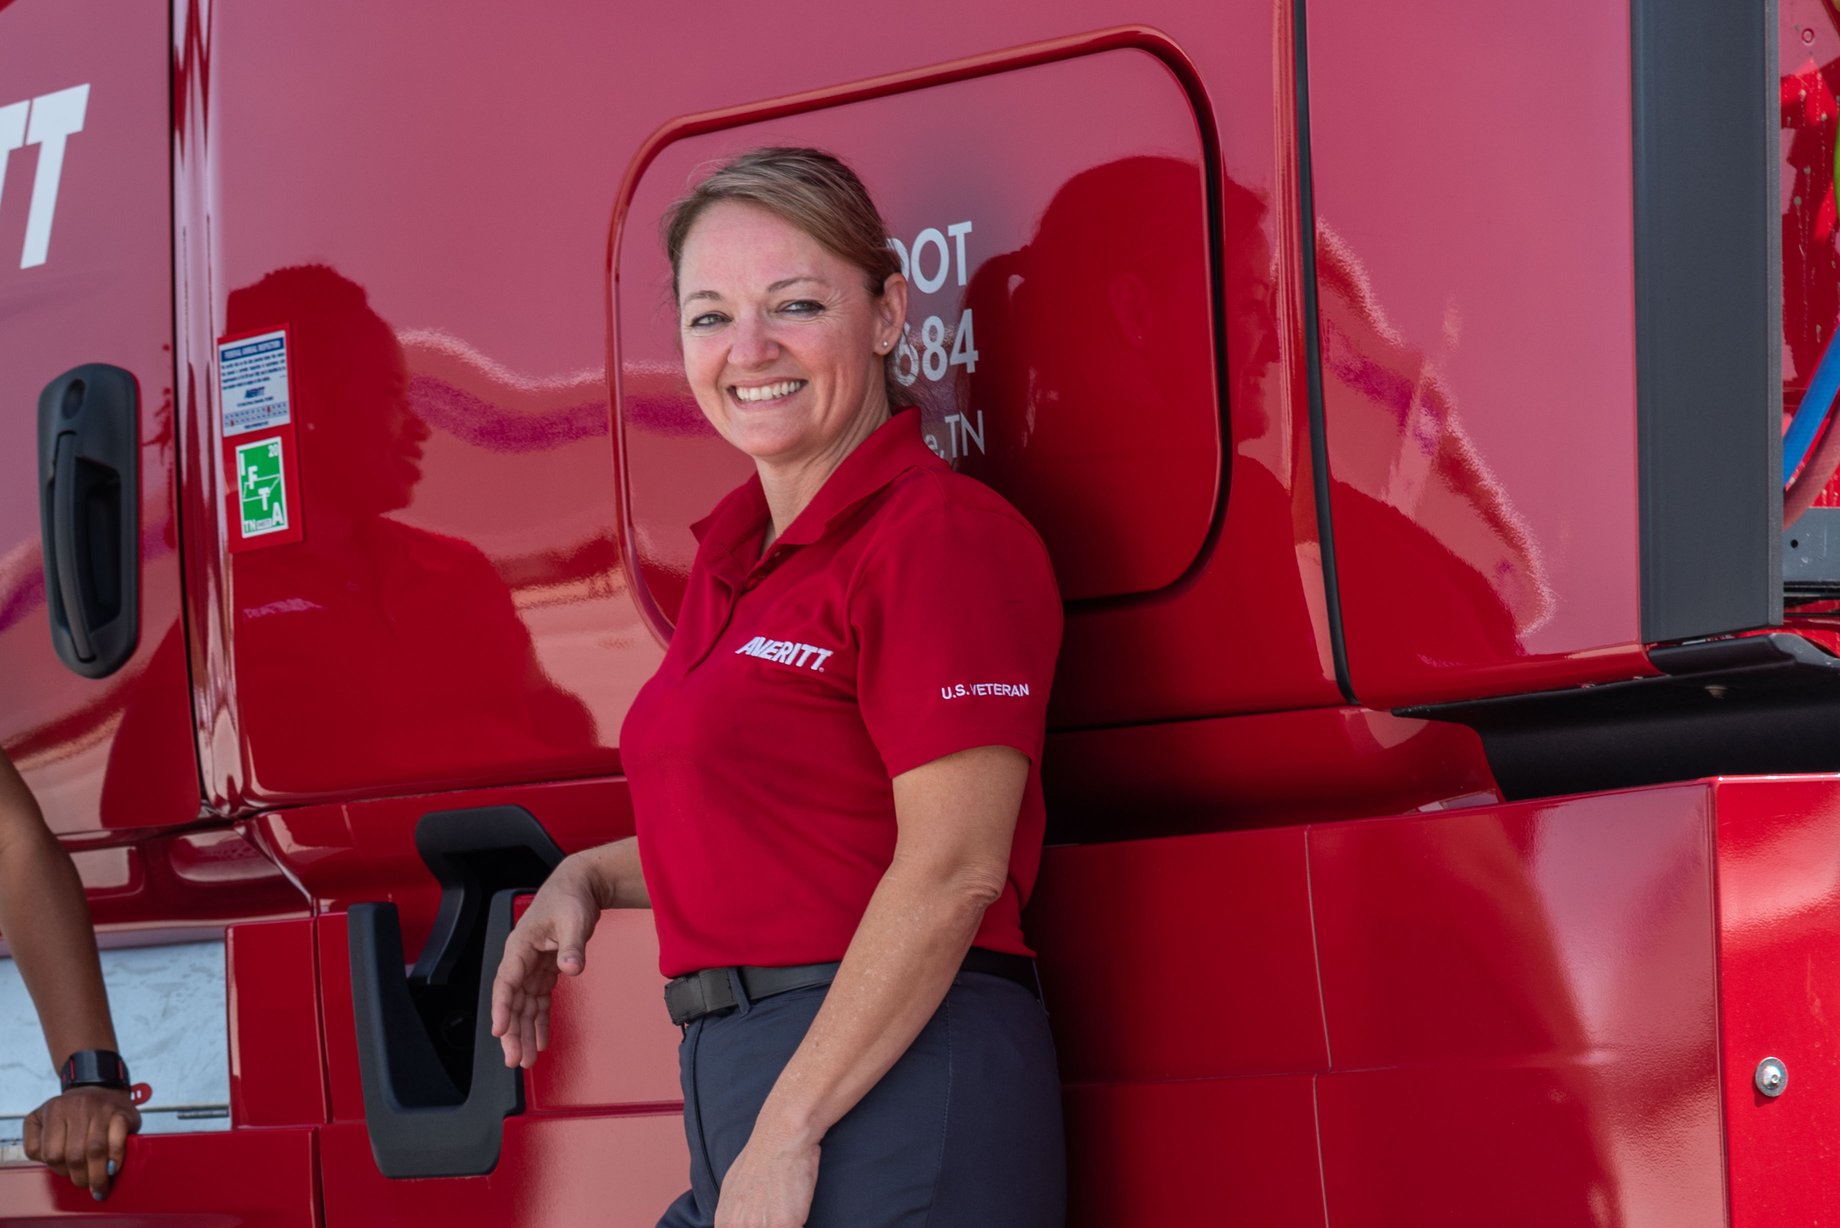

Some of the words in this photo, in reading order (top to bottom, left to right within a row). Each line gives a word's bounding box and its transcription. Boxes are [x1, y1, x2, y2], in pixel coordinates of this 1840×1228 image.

[944, 409, 986, 459] TN
[735, 636, 834, 671] AVERITT
[941, 683, 970, 700] U.S.
[970, 683, 1030, 697] VETERAN
